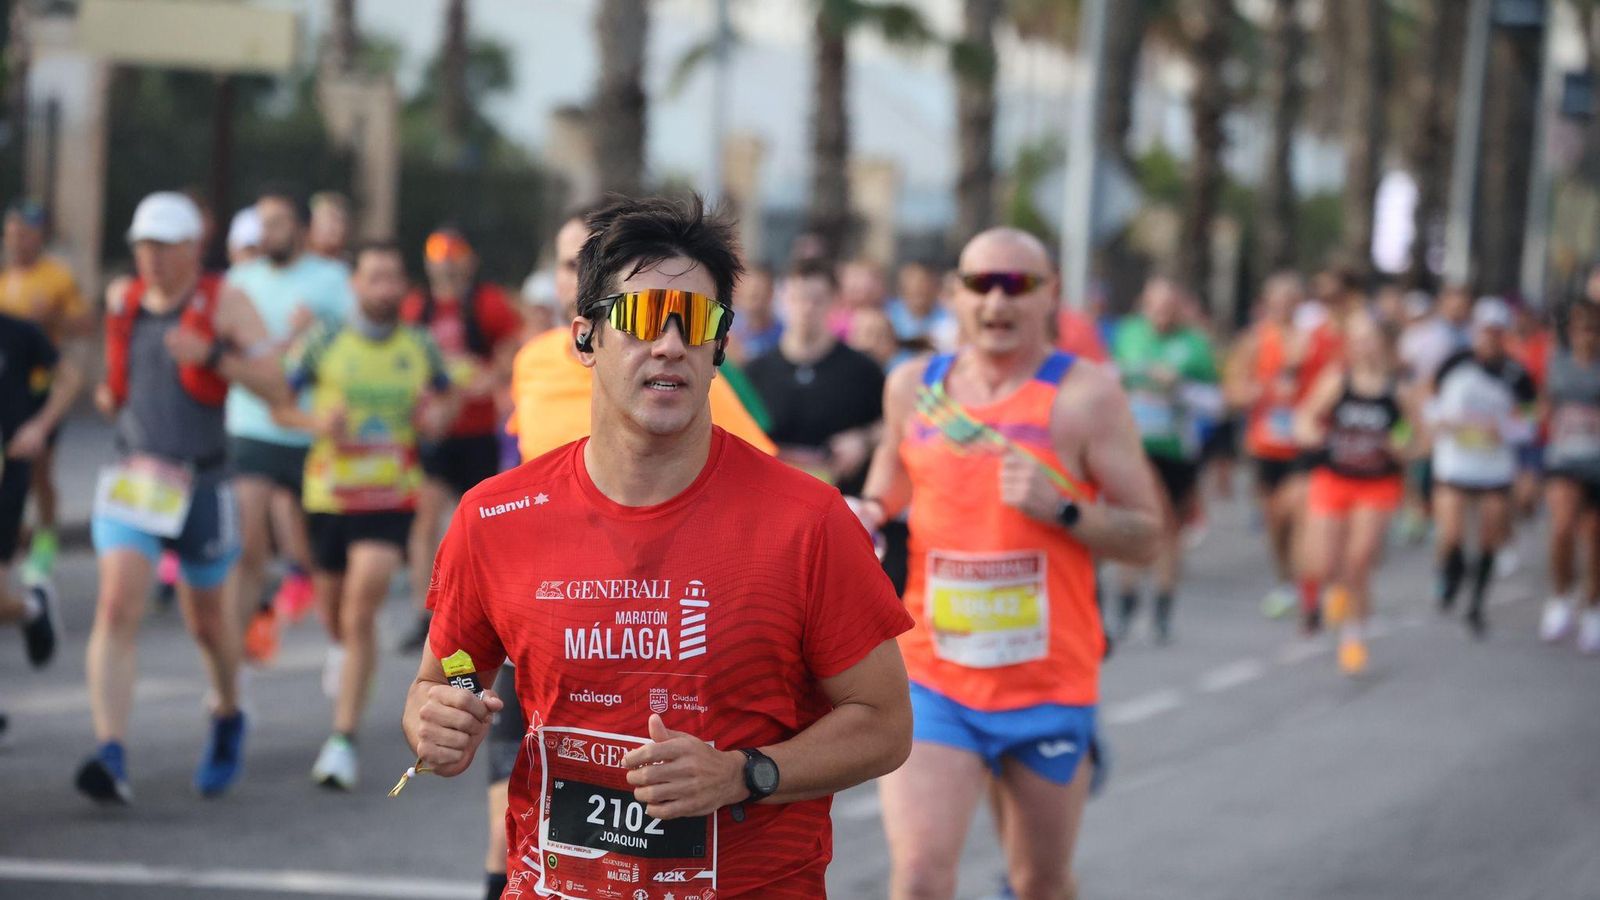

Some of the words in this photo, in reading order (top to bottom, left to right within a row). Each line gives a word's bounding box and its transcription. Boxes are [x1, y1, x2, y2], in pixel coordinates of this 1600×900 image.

[479, 496, 530, 519] luanvi
[566, 579, 671, 600] GENERALI
[615, 609, 668, 625] MARATÓN
[565, 622, 672, 660] MÁLAGA
[672, 693, 699, 702] Ciudad
[683, 703, 708, 713] Málaga
[554, 780, 565, 790] VIP
[586, 794, 665, 836] 2102
[599, 830, 648, 850] JOAQUIN
[652, 871, 687, 883] 42K
